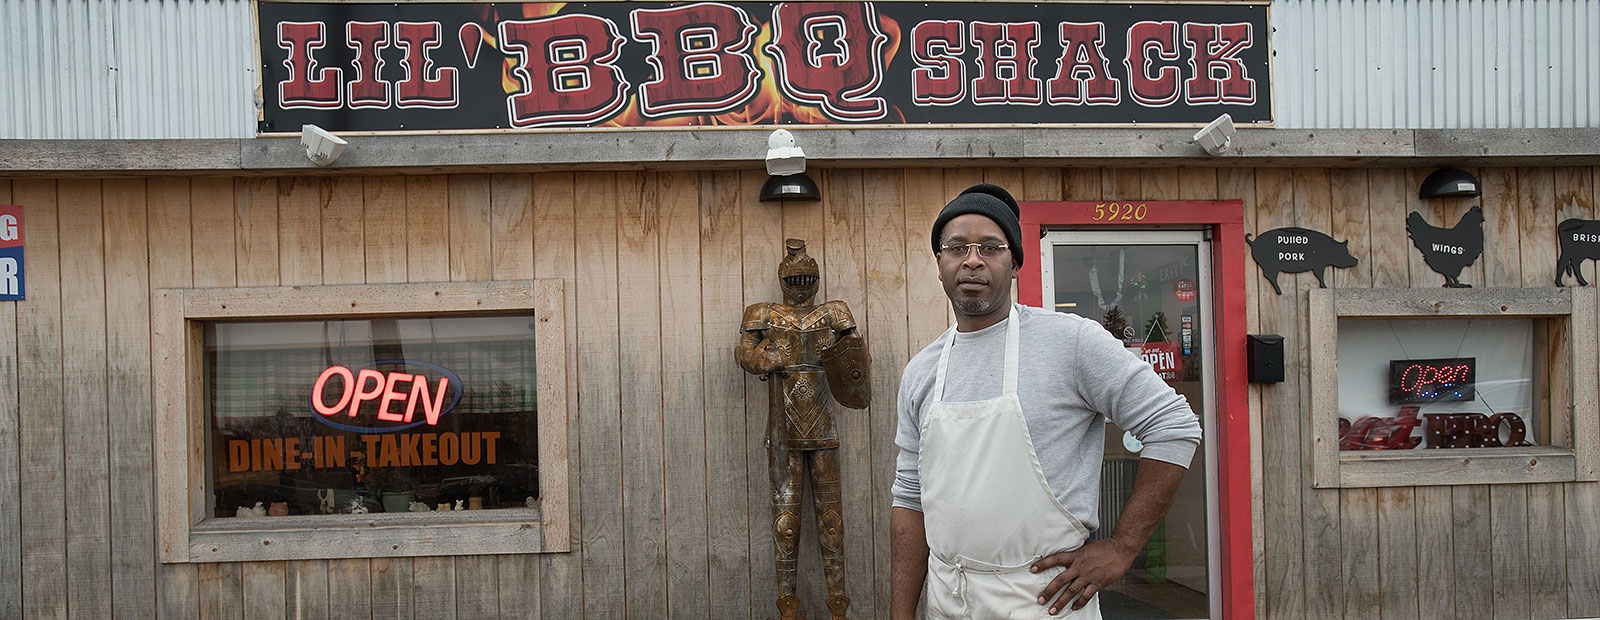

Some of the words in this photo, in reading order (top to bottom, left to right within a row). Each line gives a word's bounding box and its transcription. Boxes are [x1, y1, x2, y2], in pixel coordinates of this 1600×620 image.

[497, 1, 889, 128] BBQ
[911, 20, 1256, 106] SHACK
[1092, 202, 1148, 221] 5920
[1278, 252, 1305, 261] PORK
[312, 365, 448, 426] OPEN
